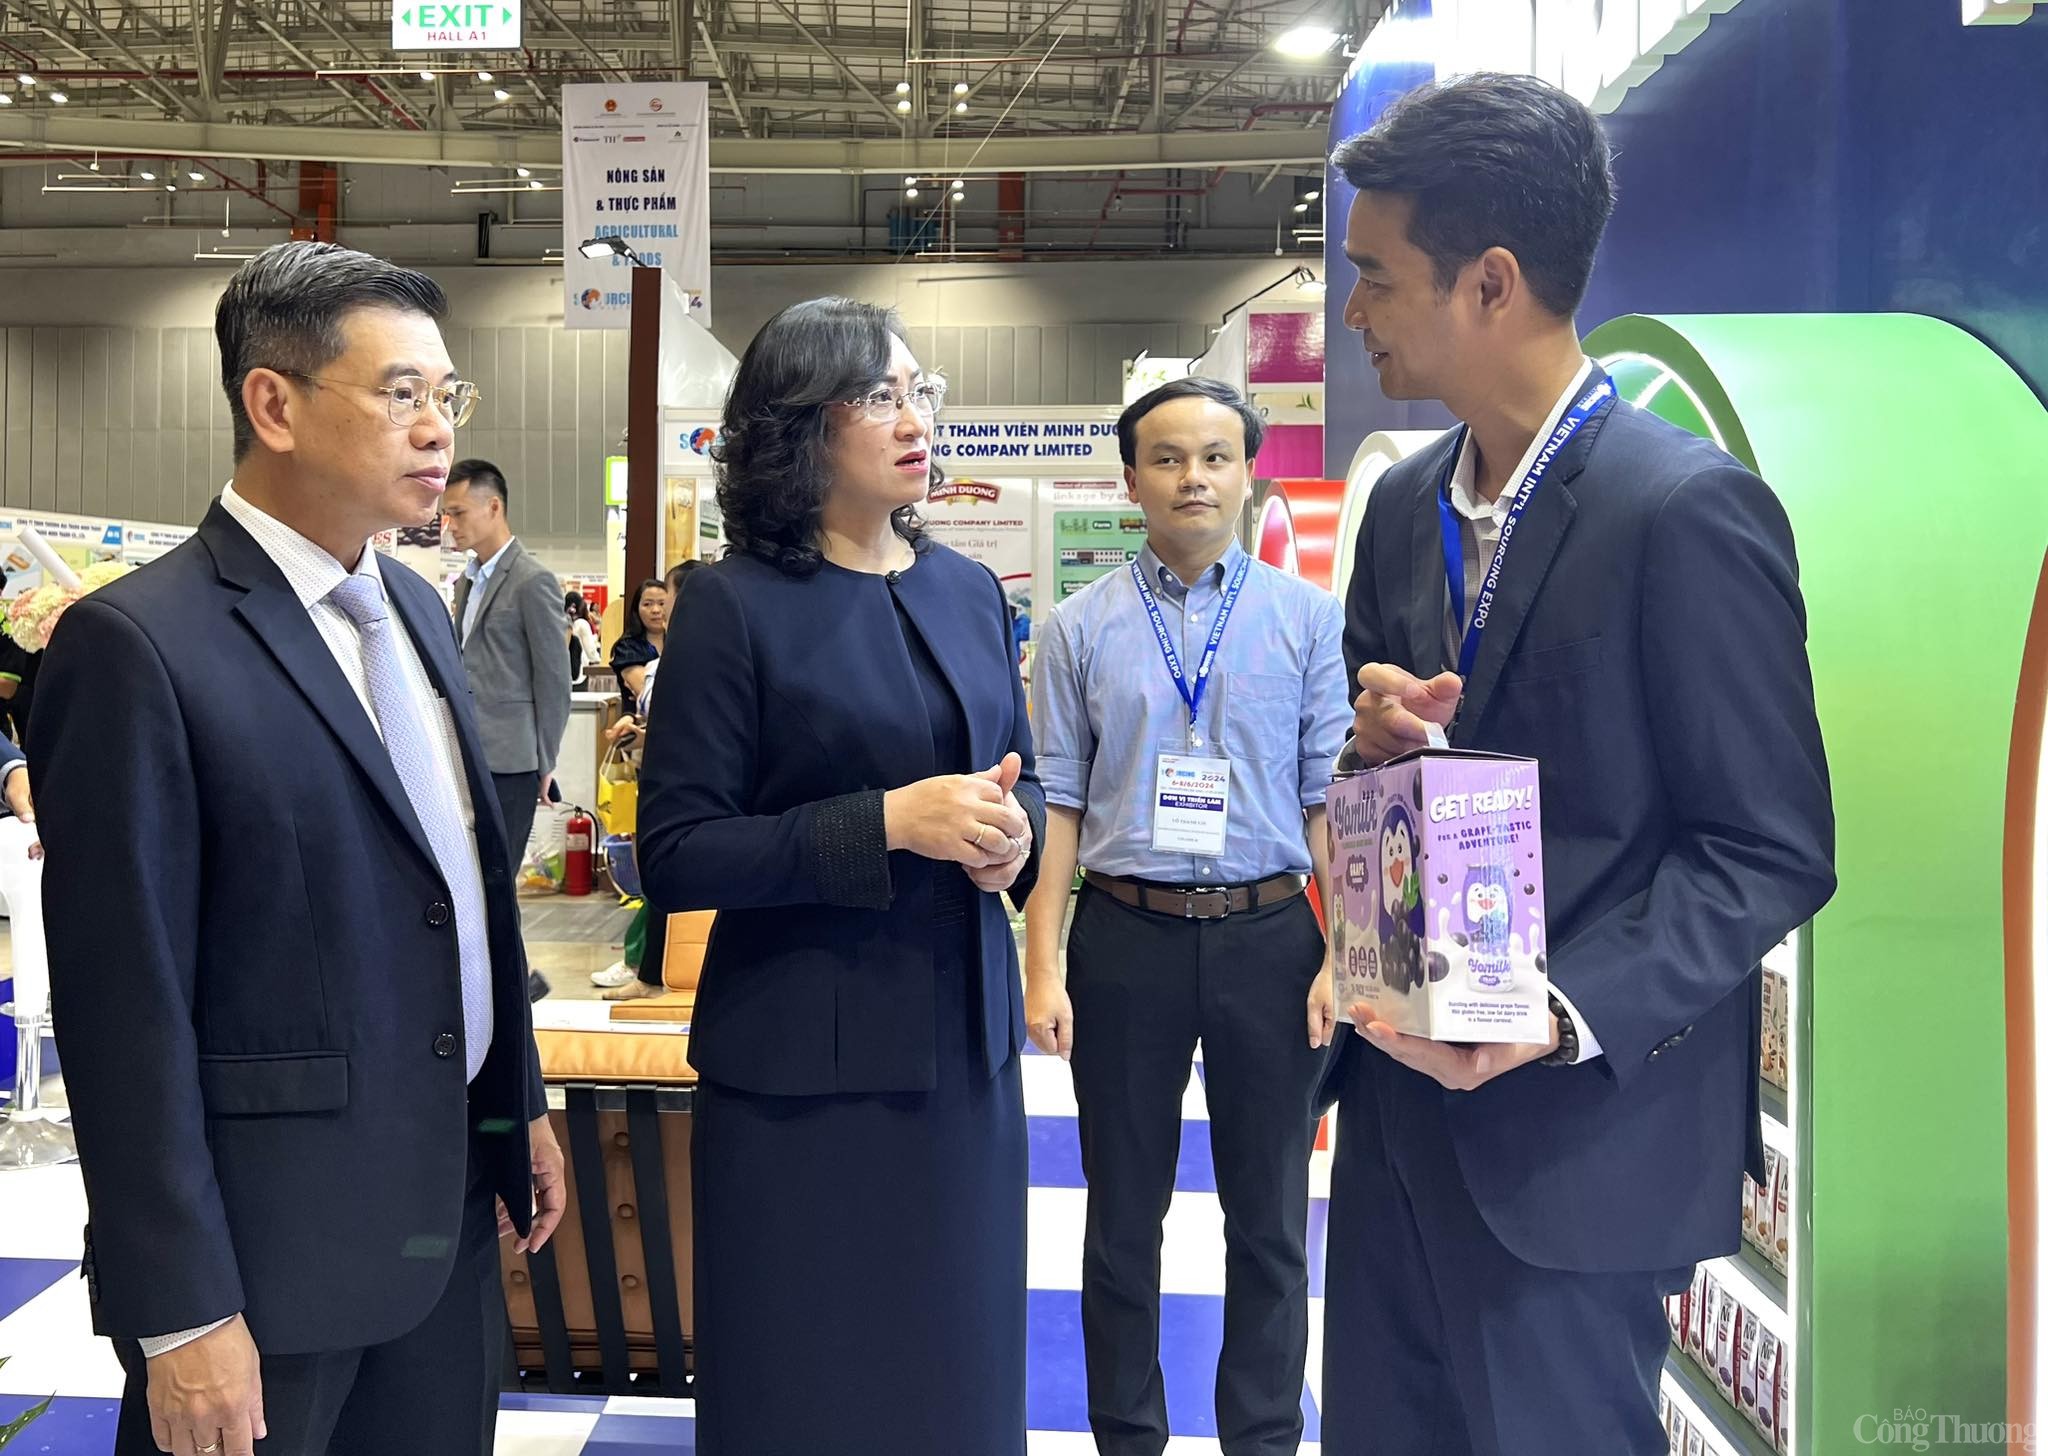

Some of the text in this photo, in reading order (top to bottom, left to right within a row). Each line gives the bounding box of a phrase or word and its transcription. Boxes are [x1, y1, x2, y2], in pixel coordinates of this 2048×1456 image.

[418, 4, 495, 28] EXIT
[427, 31, 487, 41] HALL A1
[606, 165, 666, 184] NÔNG SẢN
[596, 192, 677, 214] & THỰC PHẨM
[594, 223, 679, 240] AGRICULTURAL
[612, 253, 620, 267] &
[949, 421, 1000, 438] THÀNH
[1004, 421, 1035, 438] VIÊN
[1043, 423, 1085, 437] MINH
[956, 443, 1030, 457] COMPANY
[1034, 443, 1093, 457] LIMITED
[930, 485, 996, 499] MINH DUONG
[928, 519, 1024, 527] UONG COMPANY LIMITED
[1473, 415, 1581, 629] VIETNAM INT'L SOURCING EXPO
[1132, 563, 1149, 591] VIETNAM
[1142, 591, 1156, 611] INT'L
[1150, 610, 1172, 654] SOURCING
[1167, 654, 1182, 679] EXPO
[1208, 608, 1230, 646] VIETNAM
[1224, 590, 1238, 608] INT'L
[1201, 773, 1226, 783] 2024
[1174, 801, 1208, 810] EXHIBITOR
[1429, 793, 1469, 824] GET
[1471, 784, 1534, 817] READY!
[1460, 820, 1532, 838] GRAPE-TASTIC
[1458, 833, 1519, 851] ADVENTURE!
